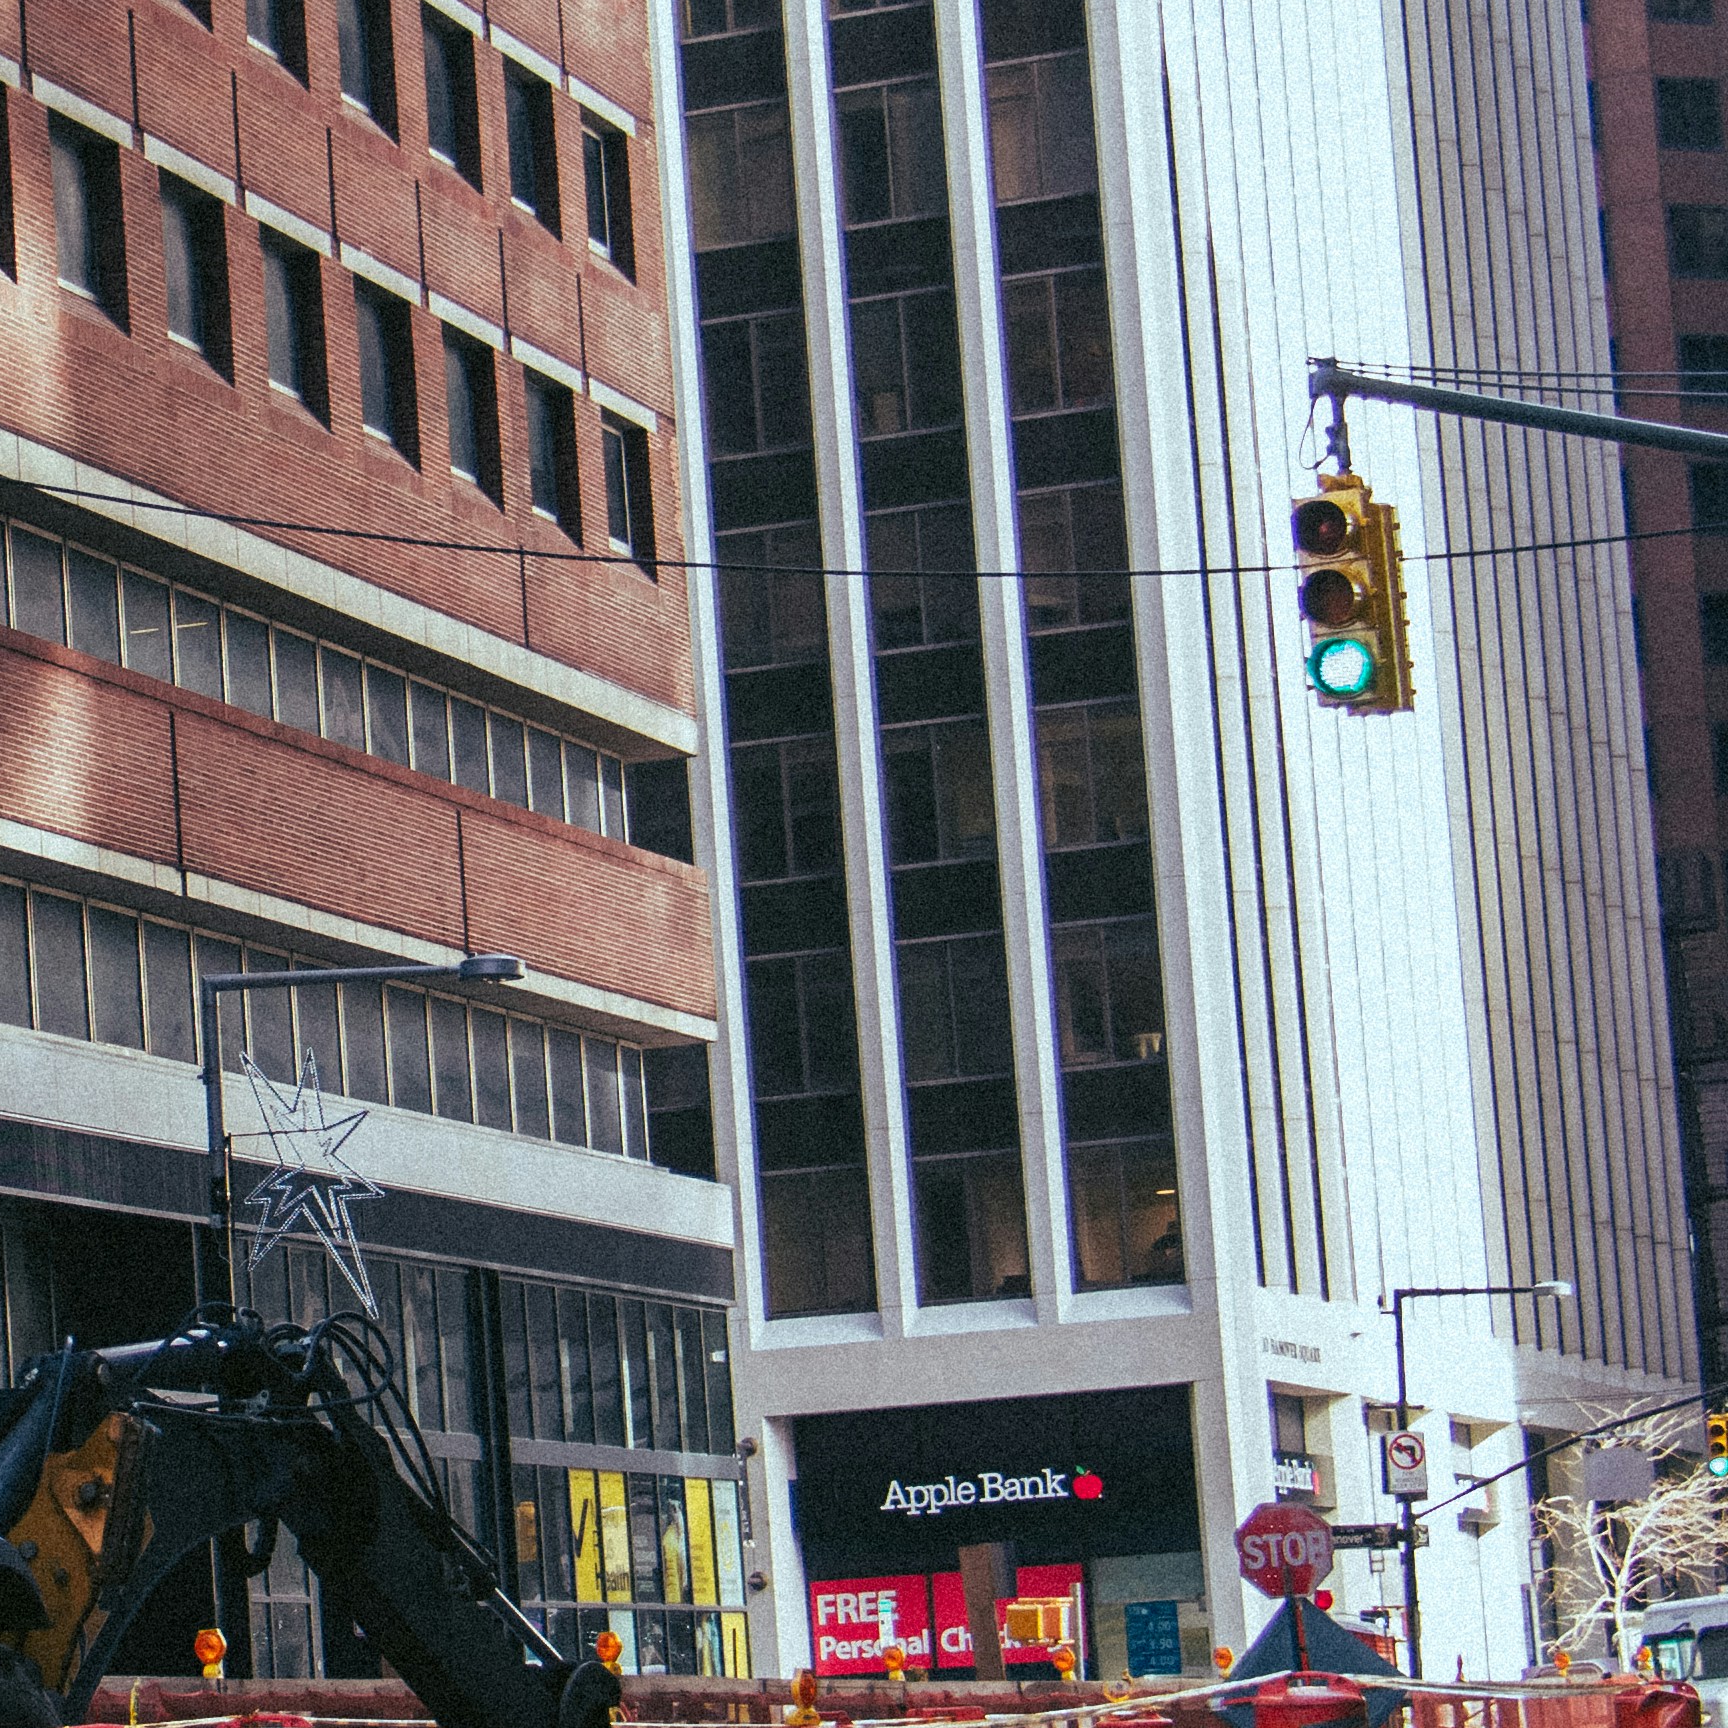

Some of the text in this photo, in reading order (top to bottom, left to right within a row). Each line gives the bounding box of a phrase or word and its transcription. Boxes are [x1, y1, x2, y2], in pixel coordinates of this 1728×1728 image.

[880, 1469, 1069, 1515] Apple Bank
[1242, 1530, 1328, 1569] STOP
